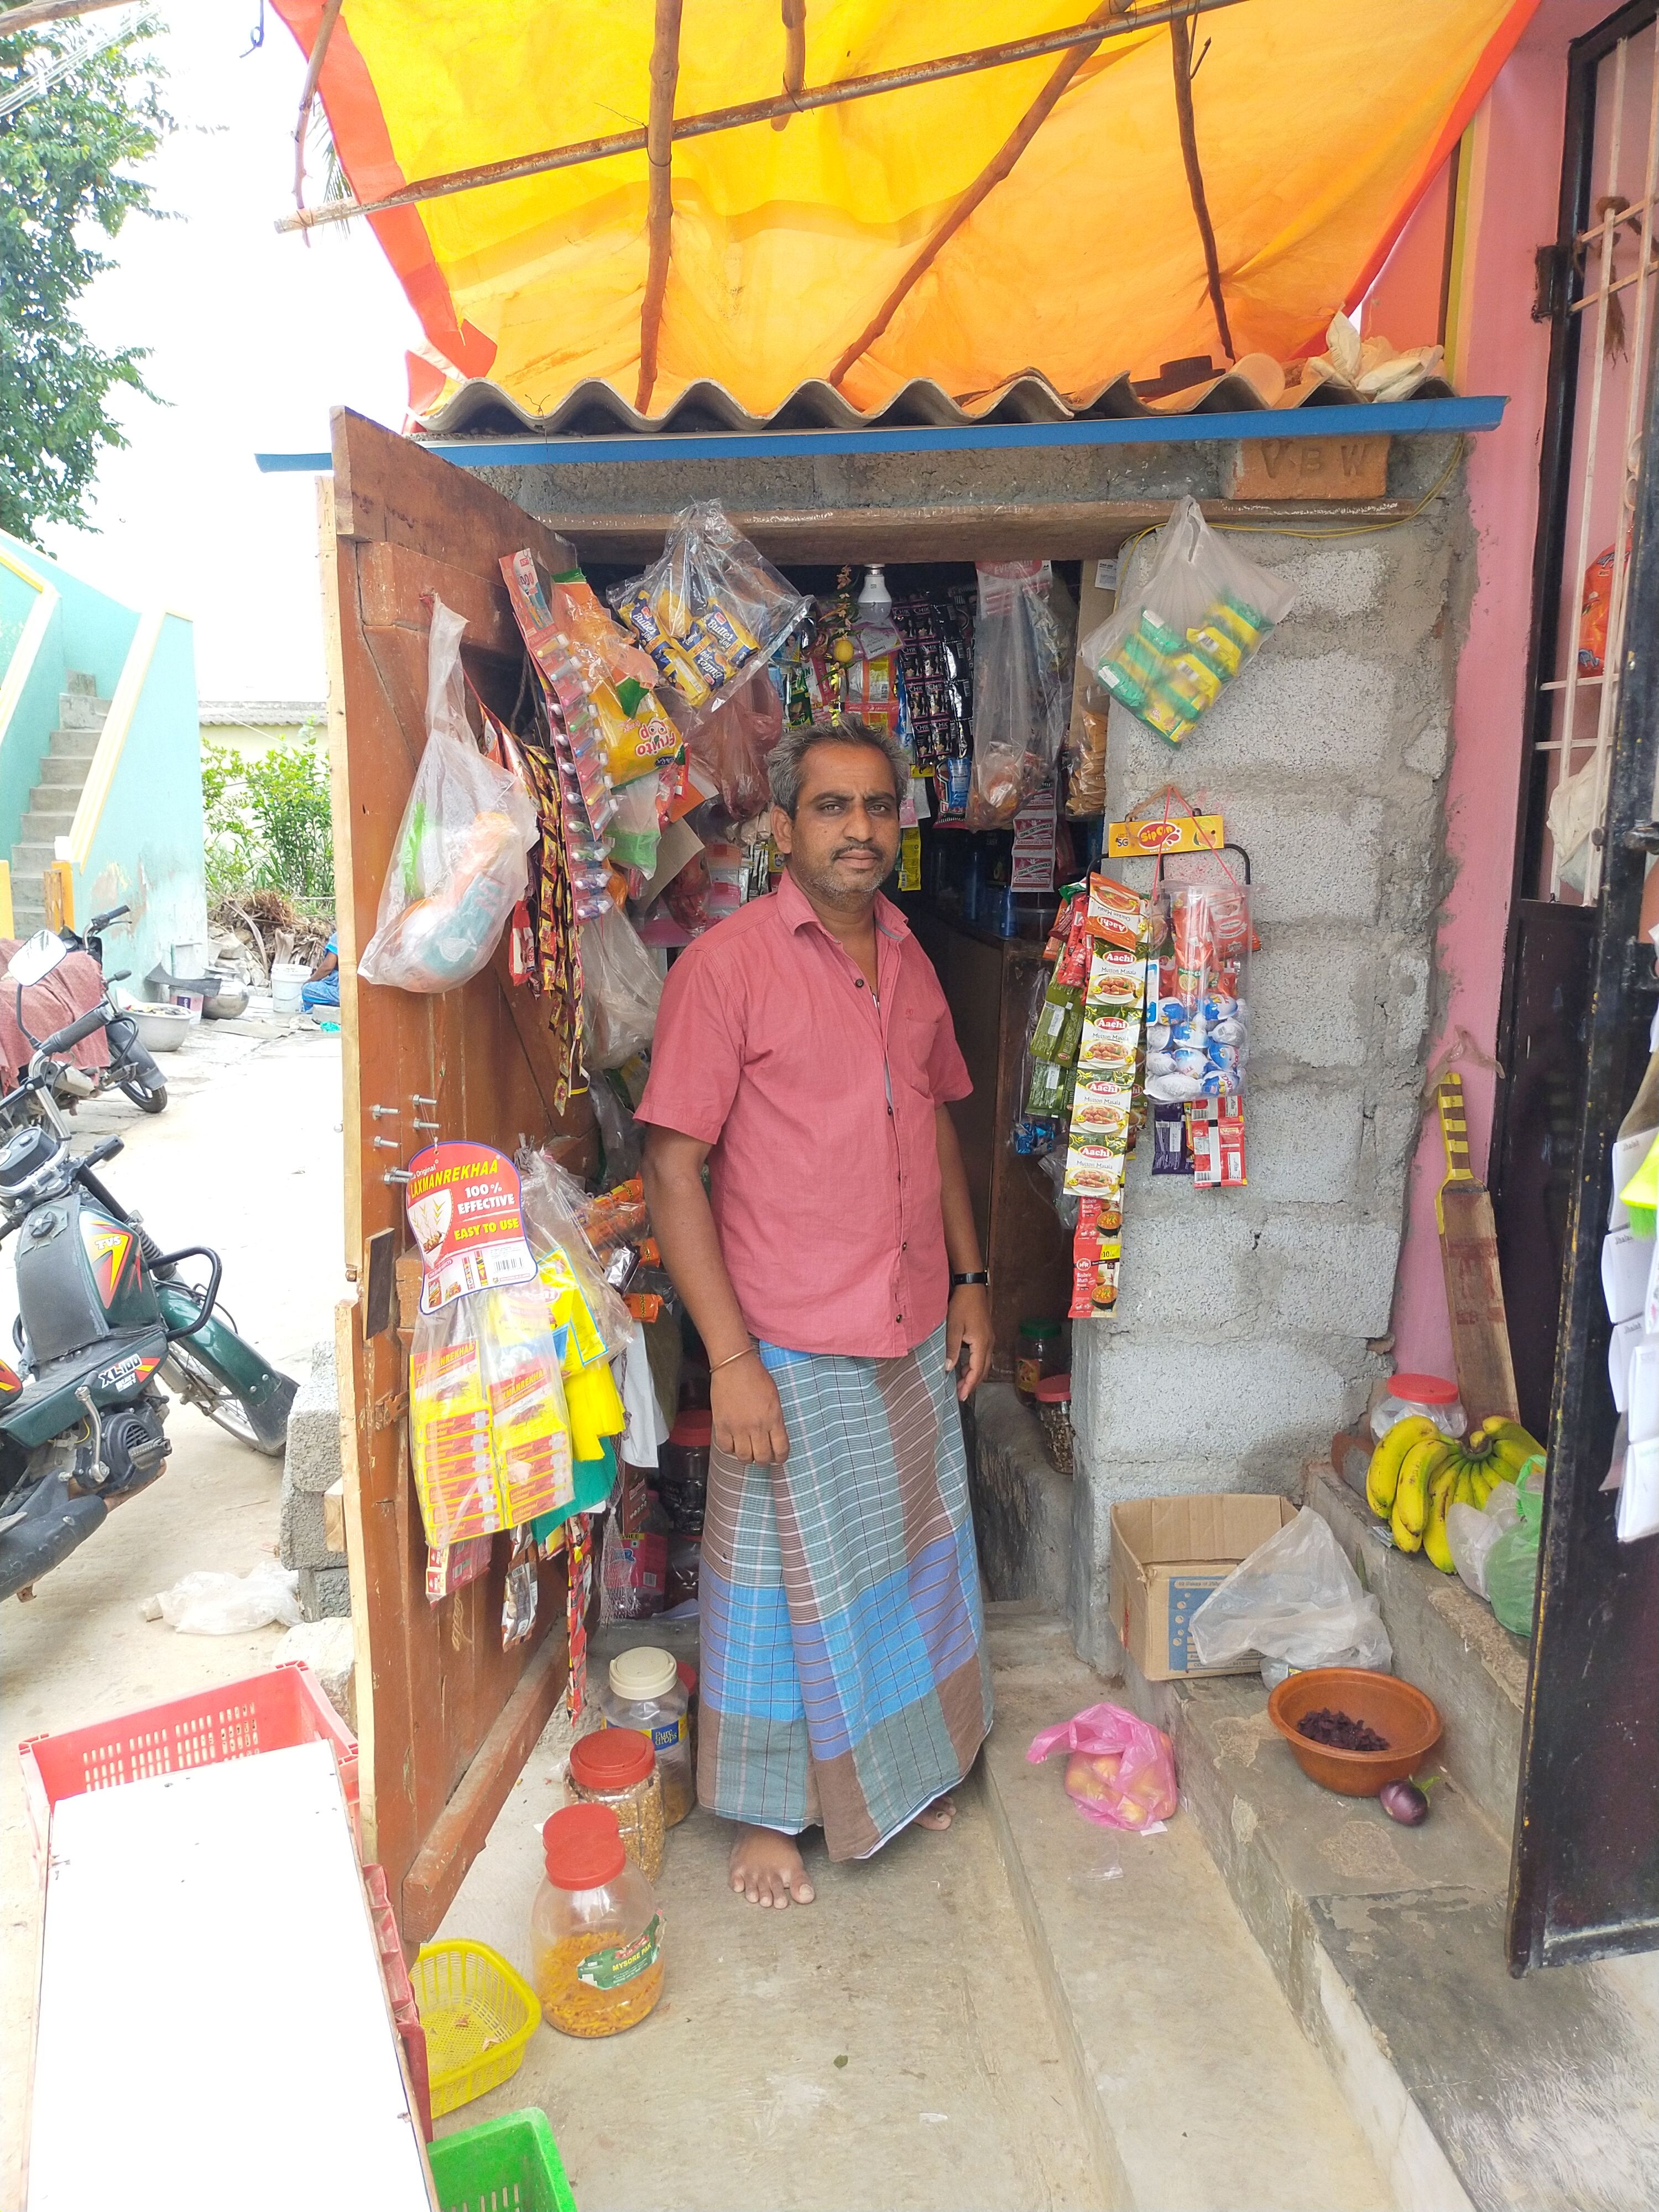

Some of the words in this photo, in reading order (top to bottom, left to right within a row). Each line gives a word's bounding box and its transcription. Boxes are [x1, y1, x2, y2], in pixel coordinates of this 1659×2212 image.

[633, 613, 658, 635] Butter
[707, 619, 733, 641] Butter
[641, 631, 653, 641] Joy
[719, 638, 731, 648] Joy
[700, 650, 712, 660] Joy
[697, 658, 722, 678] Butter
[623, 720, 640, 733] Orange
[637, 732, 675, 755] Fruito
[1114, 912, 1130, 921] Chicken
[1100, 917, 1125, 932] Aachi
[1106, 953, 1133, 963] Aachi
[1098, 1019, 1125, 1029] Aachi
[1089, 1084, 1118, 1093] Aachi
[1082, 1147, 1110, 1157] Aachi
[416, 1164, 436, 1177] Original
[410, 1159, 498, 1199] LAXMANREKHAA
[457, 1193, 514, 1214] EFFECTIVE
[454, 1224, 481, 1240] EASY
[483, 1222, 497, 1233] TO
[499, 1218, 519, 1230] USE
[95, 1235, 121, 1250] TVS
[655, 1729, 672, 1740] Pure
[655, 1733, 677, 1745] drops
[612, 1952, 640, 1971] MYSORE
[641, 1942, 652, 1955] PAK
